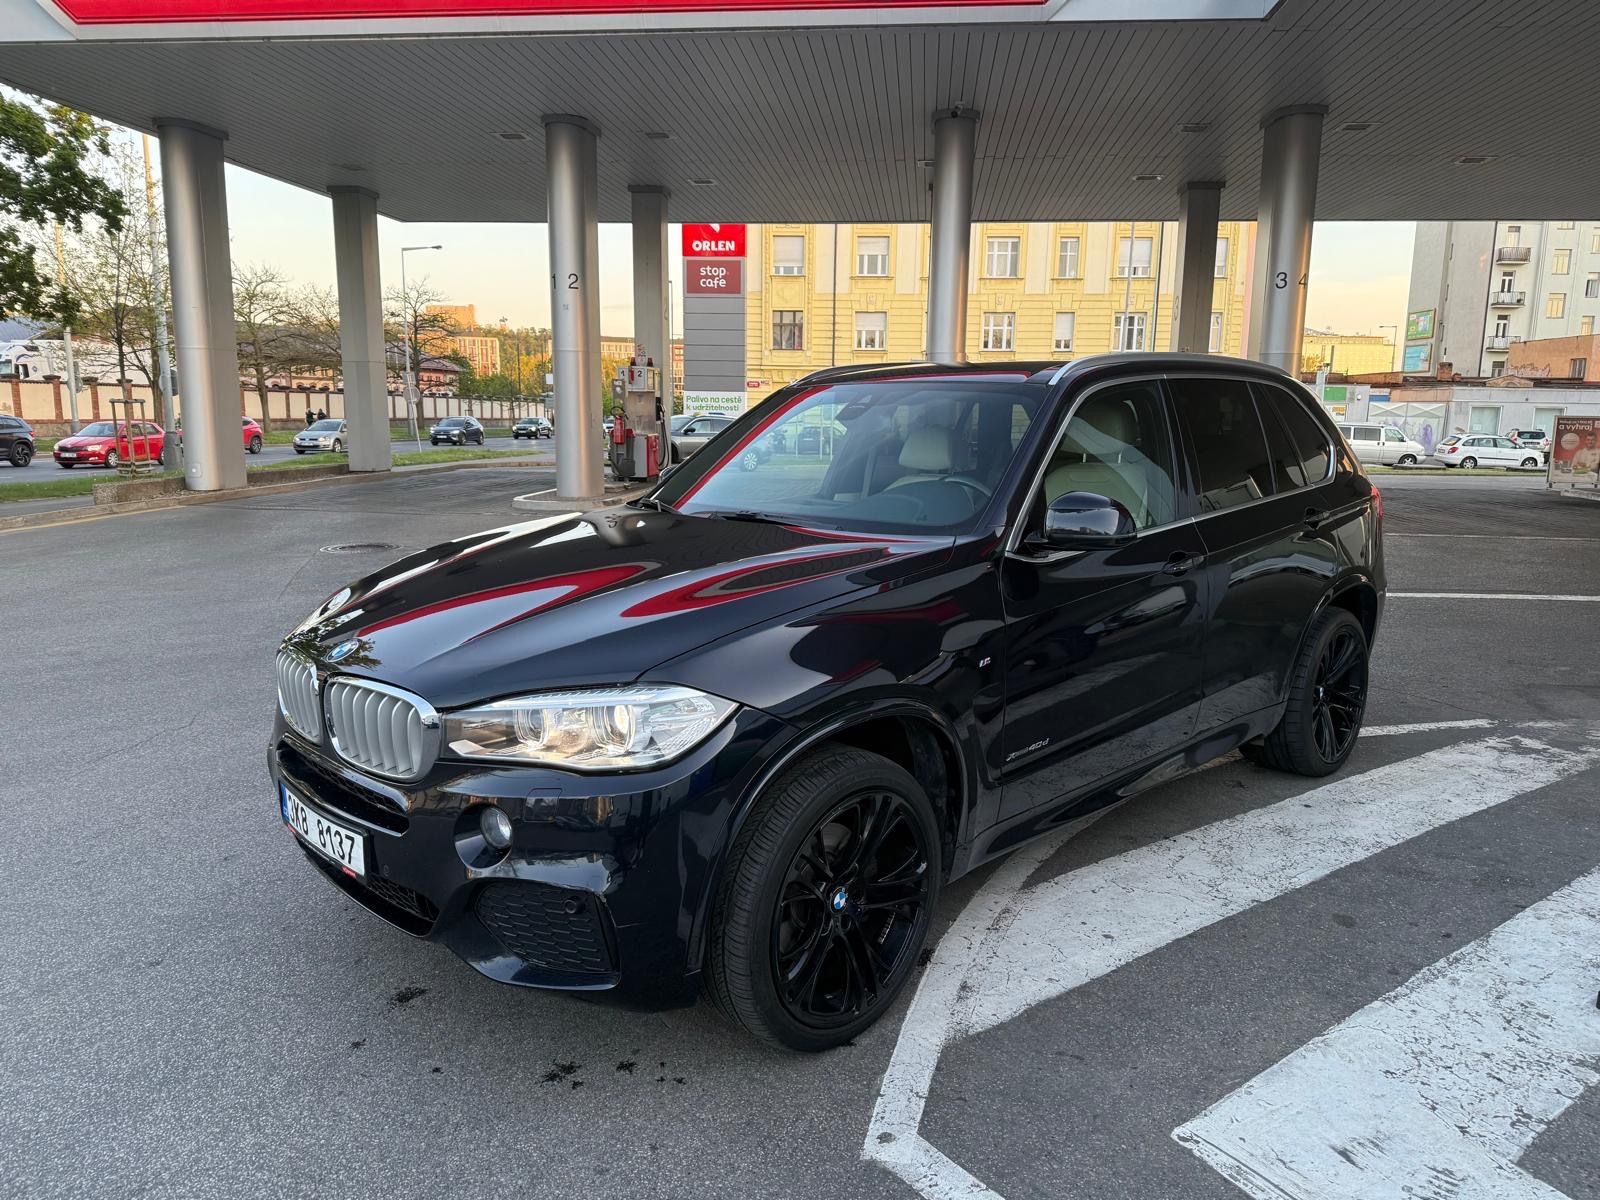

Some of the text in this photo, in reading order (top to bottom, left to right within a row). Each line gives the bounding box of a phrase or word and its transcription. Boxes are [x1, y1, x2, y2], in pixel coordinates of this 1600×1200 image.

[692, 240, 736, 251] ORLEN
[700, 265, 726, 278] stop
[551, 273, 579, 289] 1 2
[700, 277, 727, 288] cafe
[1275, 271, 1308, 289] 3 4
[637, 370, 643, 378] 2
[686, 395, 709, 403] Palivo
[721, 395, 743, 404] cestě
[1566, 423, 1593, 431] vyhraj
[316, 818, 355, 865] 8137
